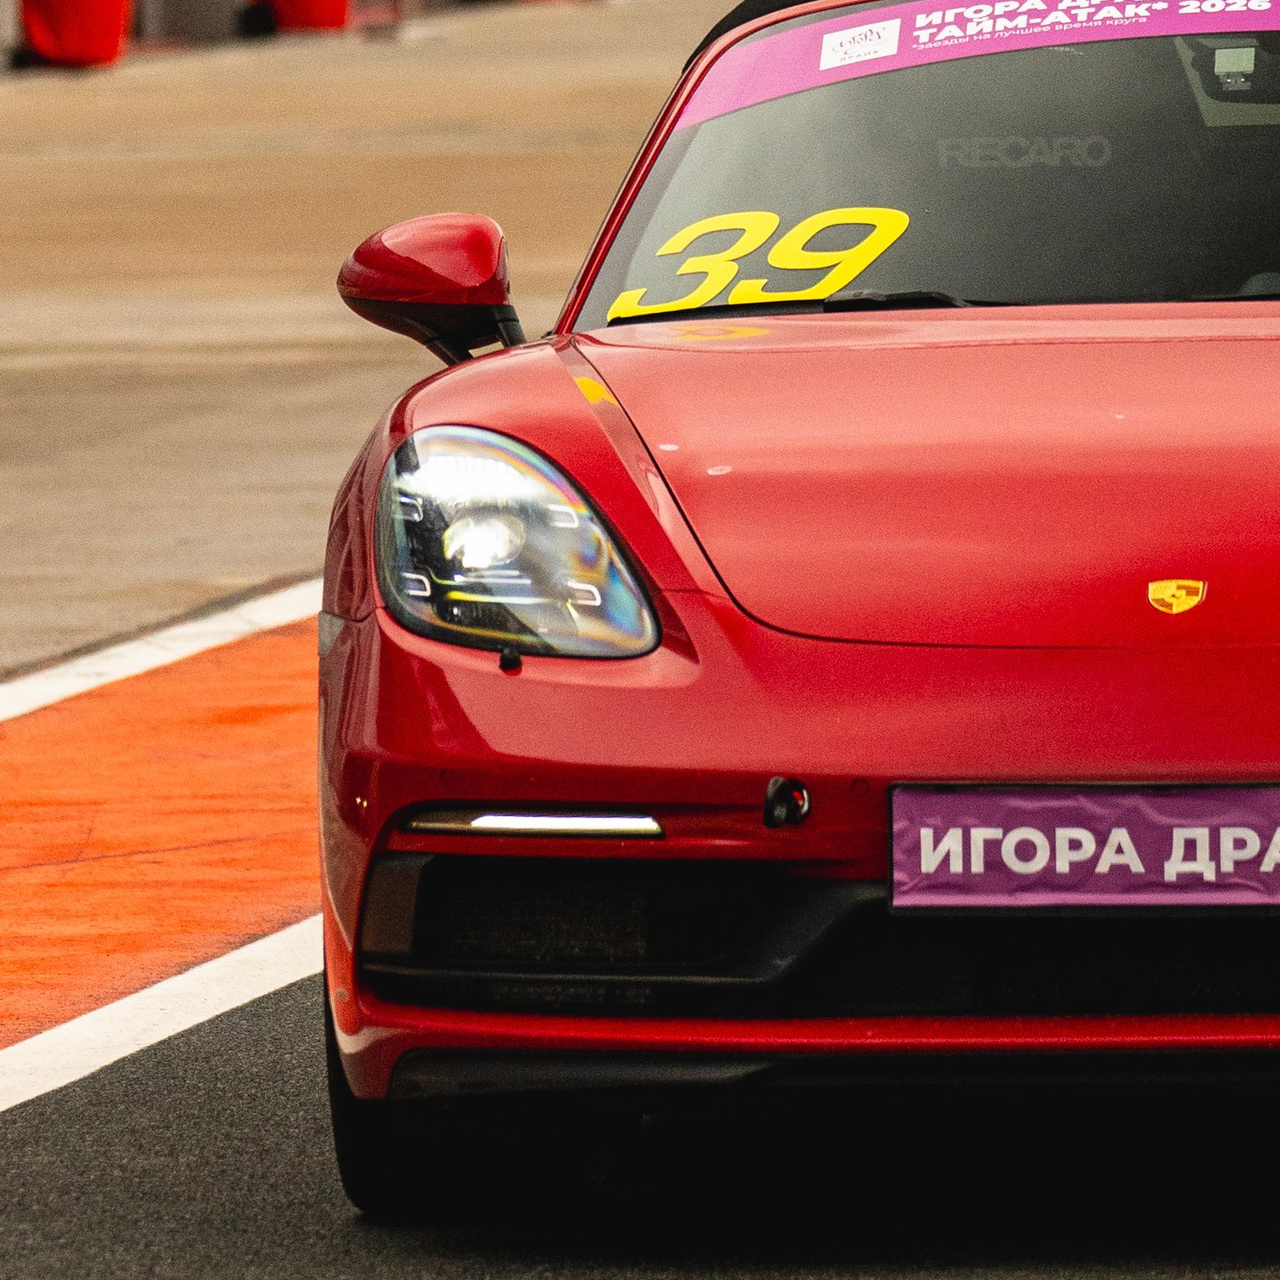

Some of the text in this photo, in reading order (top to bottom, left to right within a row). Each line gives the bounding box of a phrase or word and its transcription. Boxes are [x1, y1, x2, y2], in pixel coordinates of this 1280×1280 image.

[973, 33, 990, 41] на
[994, 26, 1051, 38] лучшее
[1055, 20, 1102, 31] время
[1106, 17, 1147, 26] круга
[937, 134, 1112, 168] RECARO
[606, 207, 910, 322] 39
[919, 826, 1145, 875] ИГОРА
